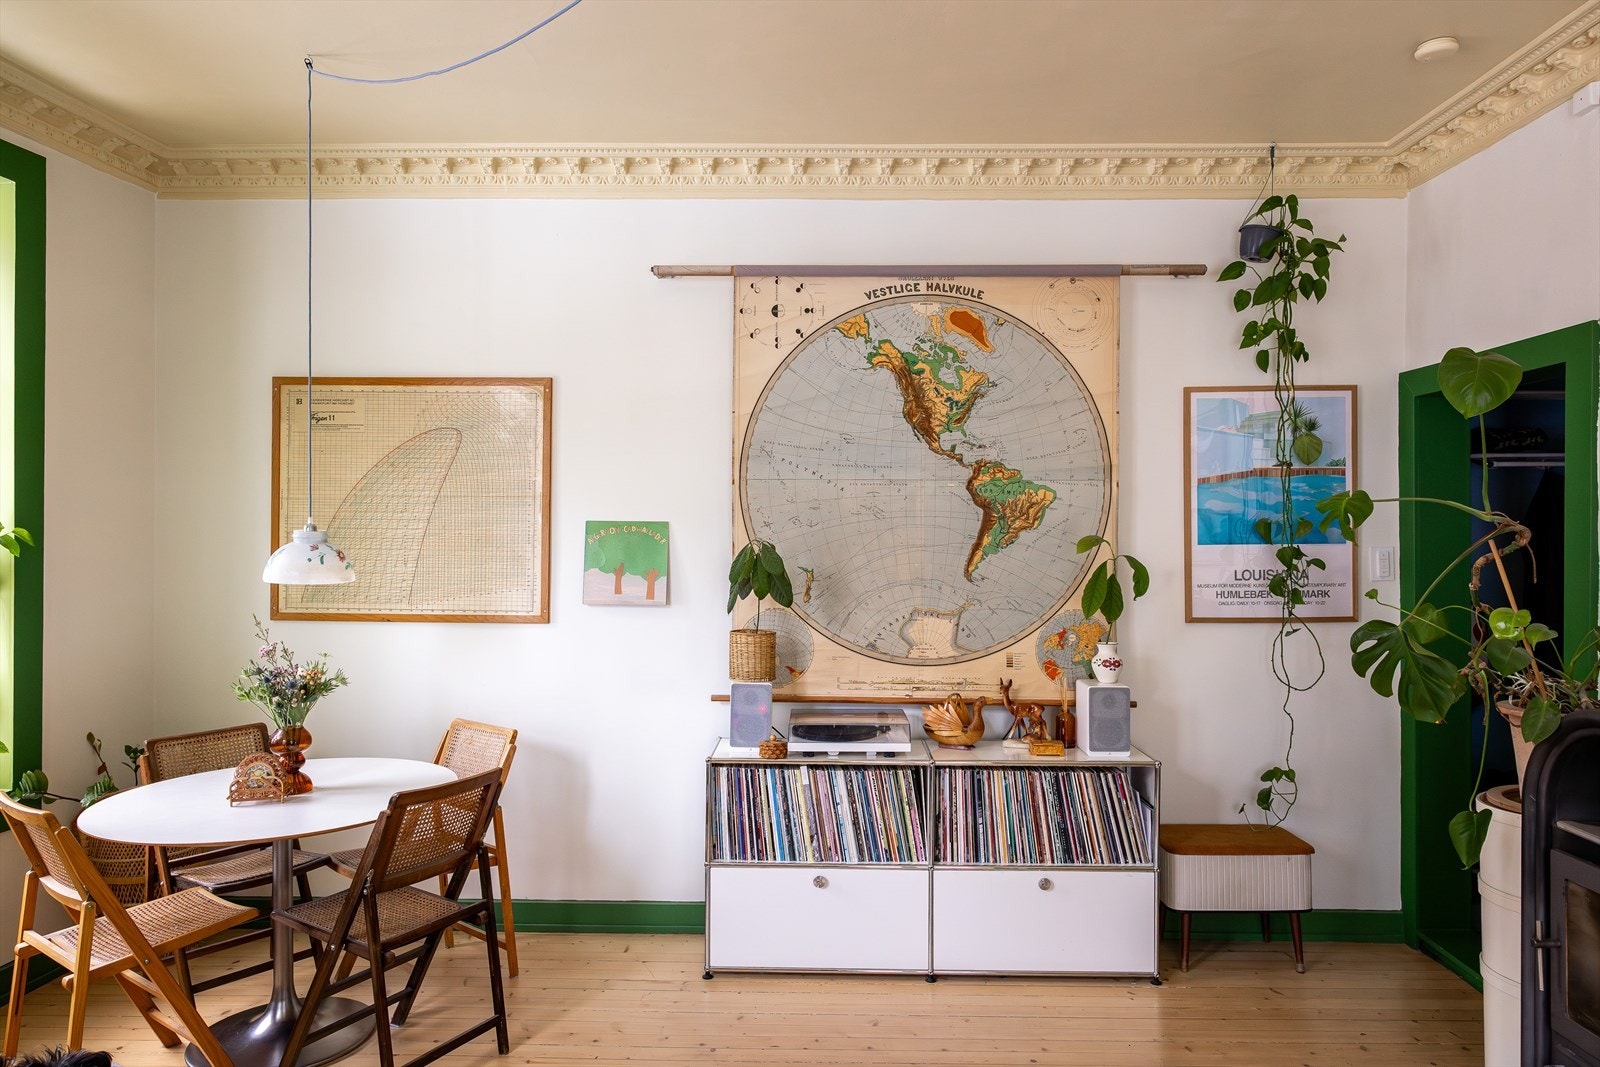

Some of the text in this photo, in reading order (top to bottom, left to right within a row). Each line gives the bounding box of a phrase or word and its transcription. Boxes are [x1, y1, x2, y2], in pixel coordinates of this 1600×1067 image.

[864, 282, 985, 300] VESTLIGE HALVKULE
[1234, 569, 1310, 581] LOUISNA
[1215, 589, 1331, 599] HUMLEBÆK MARK
